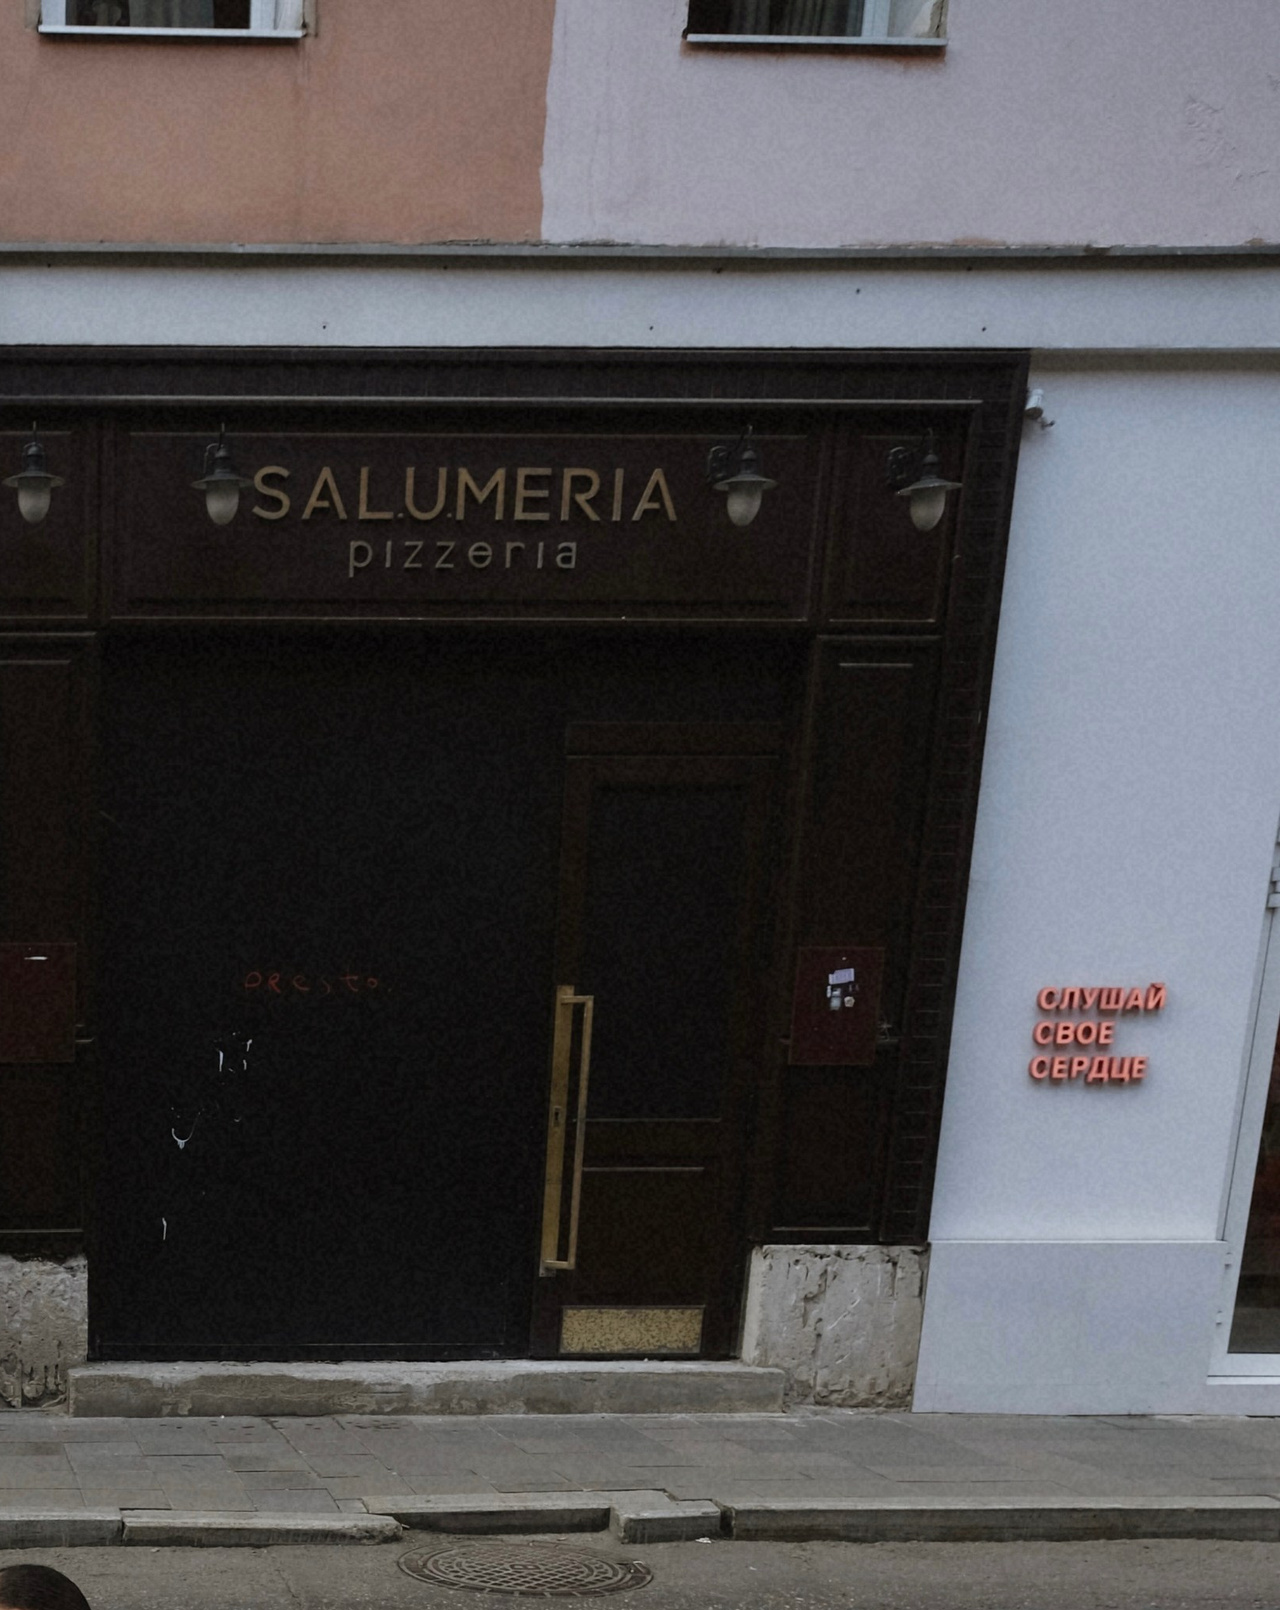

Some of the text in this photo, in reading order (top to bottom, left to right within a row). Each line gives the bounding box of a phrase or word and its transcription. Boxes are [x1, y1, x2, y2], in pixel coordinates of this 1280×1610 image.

[348, 541, 577, 578] pizzeria
[1038, 983, 1167, 1012] СЛУШАЙ
[1034, 1021, 1115, 1044] СВОЕ
[1029, 1056, 1147, 1082] СЕРДЦЕ
